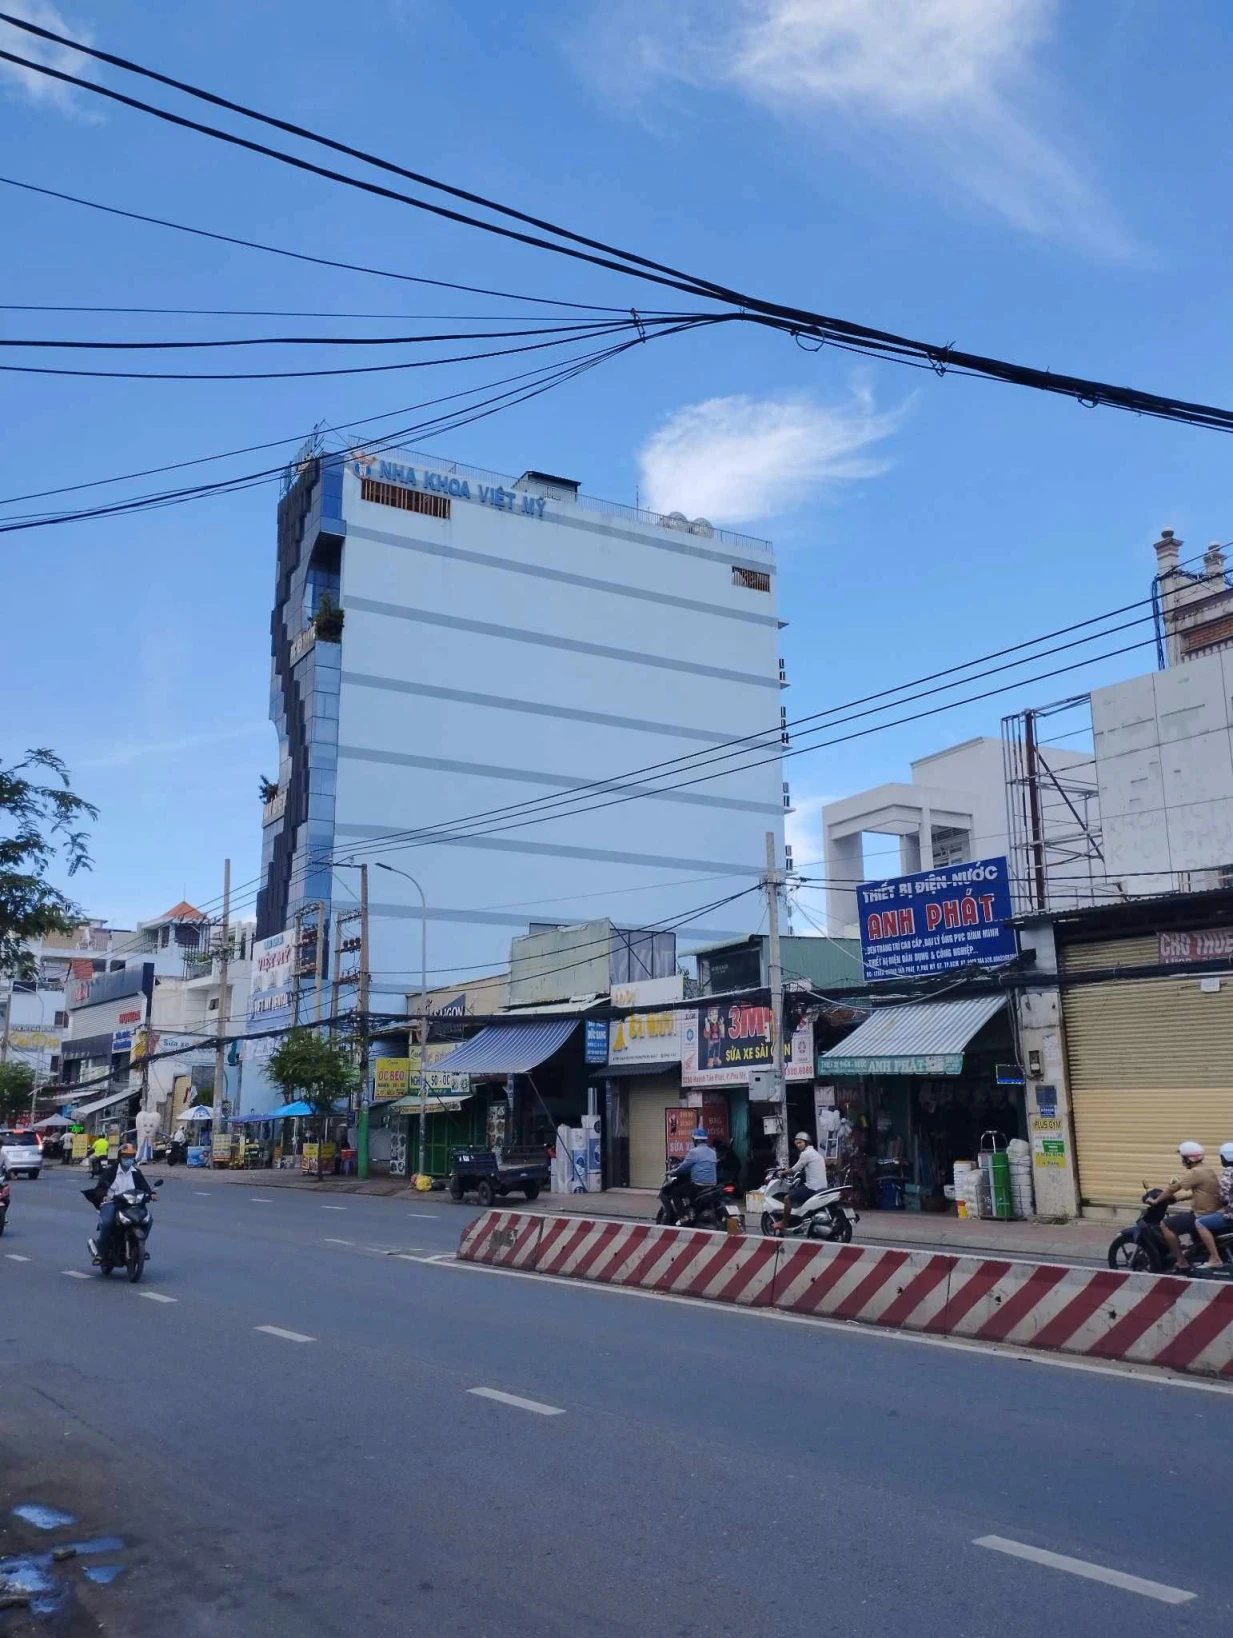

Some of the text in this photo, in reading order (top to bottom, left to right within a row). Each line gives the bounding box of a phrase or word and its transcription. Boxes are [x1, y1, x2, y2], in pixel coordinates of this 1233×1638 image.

[379, 459, 416, 486] NHA
[424, 470, 470, 499] KHOA
[478, 484, 516, 511] VIỆT
[867, 887, 996, 941] ANH PHÁT
[1160, 933, 1191, 956] CHO
[725, 1042, 741, 1061] SỬA
[743, 1047, 753, 1060] XE
[755, 1043, 769, 1059] SÀI
